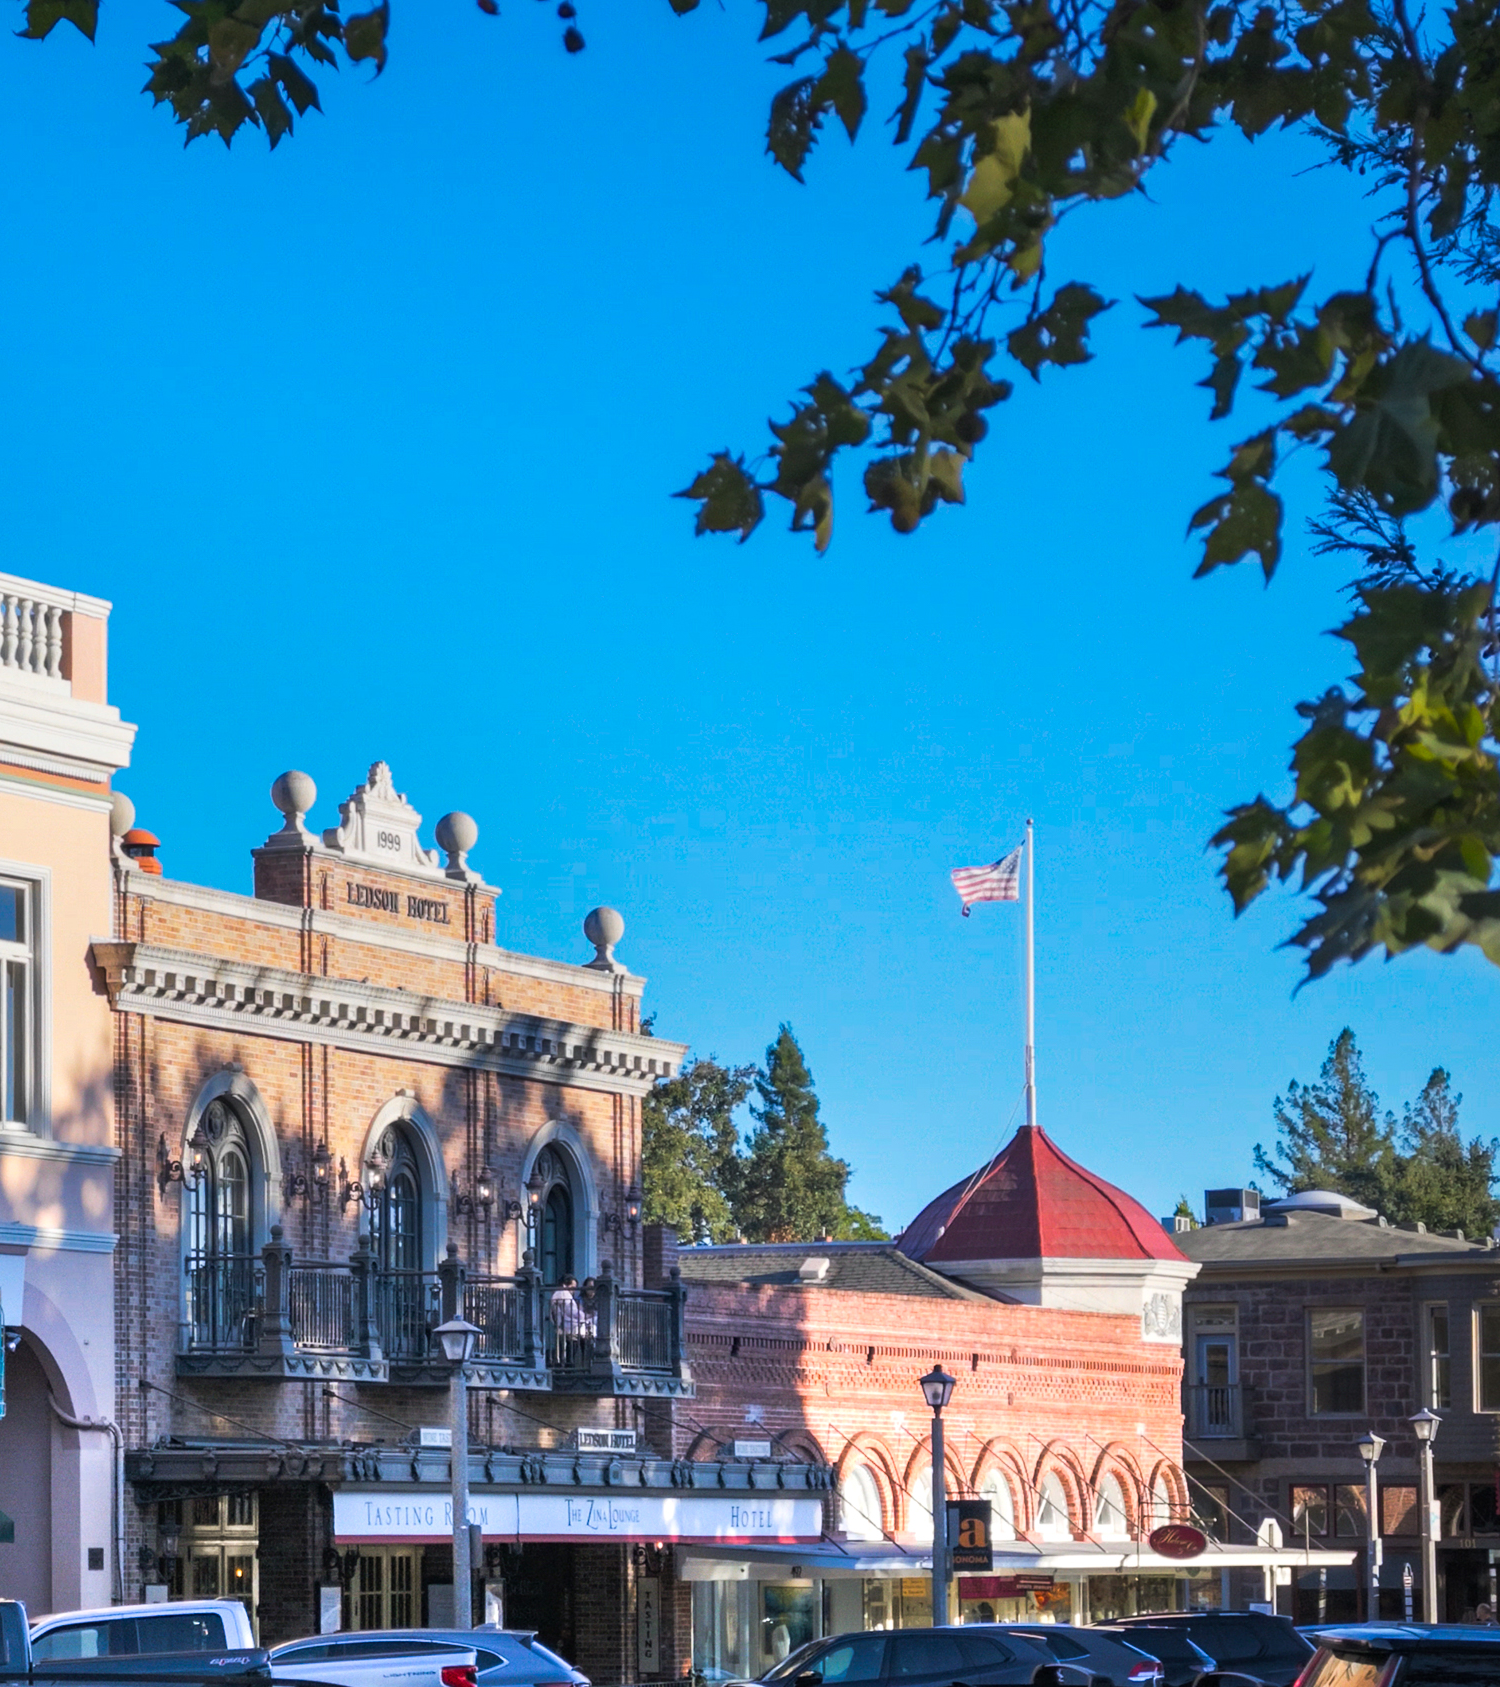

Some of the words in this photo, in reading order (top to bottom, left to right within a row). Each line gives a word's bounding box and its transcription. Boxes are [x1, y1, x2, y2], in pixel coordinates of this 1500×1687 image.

[377, 830, 401, 852] 1999
[346, 881, 400, 914] LEDSON
[406, 895, 451, 925] HOTEL
[579, 1432, 609, 1448] LEDSON
[610, 1434, 636, 1449] HOTEL
[364, 1501, 434, 1526] TASTING
[444, 1501, 489, 1526] ROM
[586, 1500, 607, 1530] ZINA
[607, 1500, 640, 1530] LOUNGE
[730, 1506, 773, 1528] HOTEL
[1460, 1538, 1477, 1549] 101
[644, 1591, 653, 1658] TASTING
